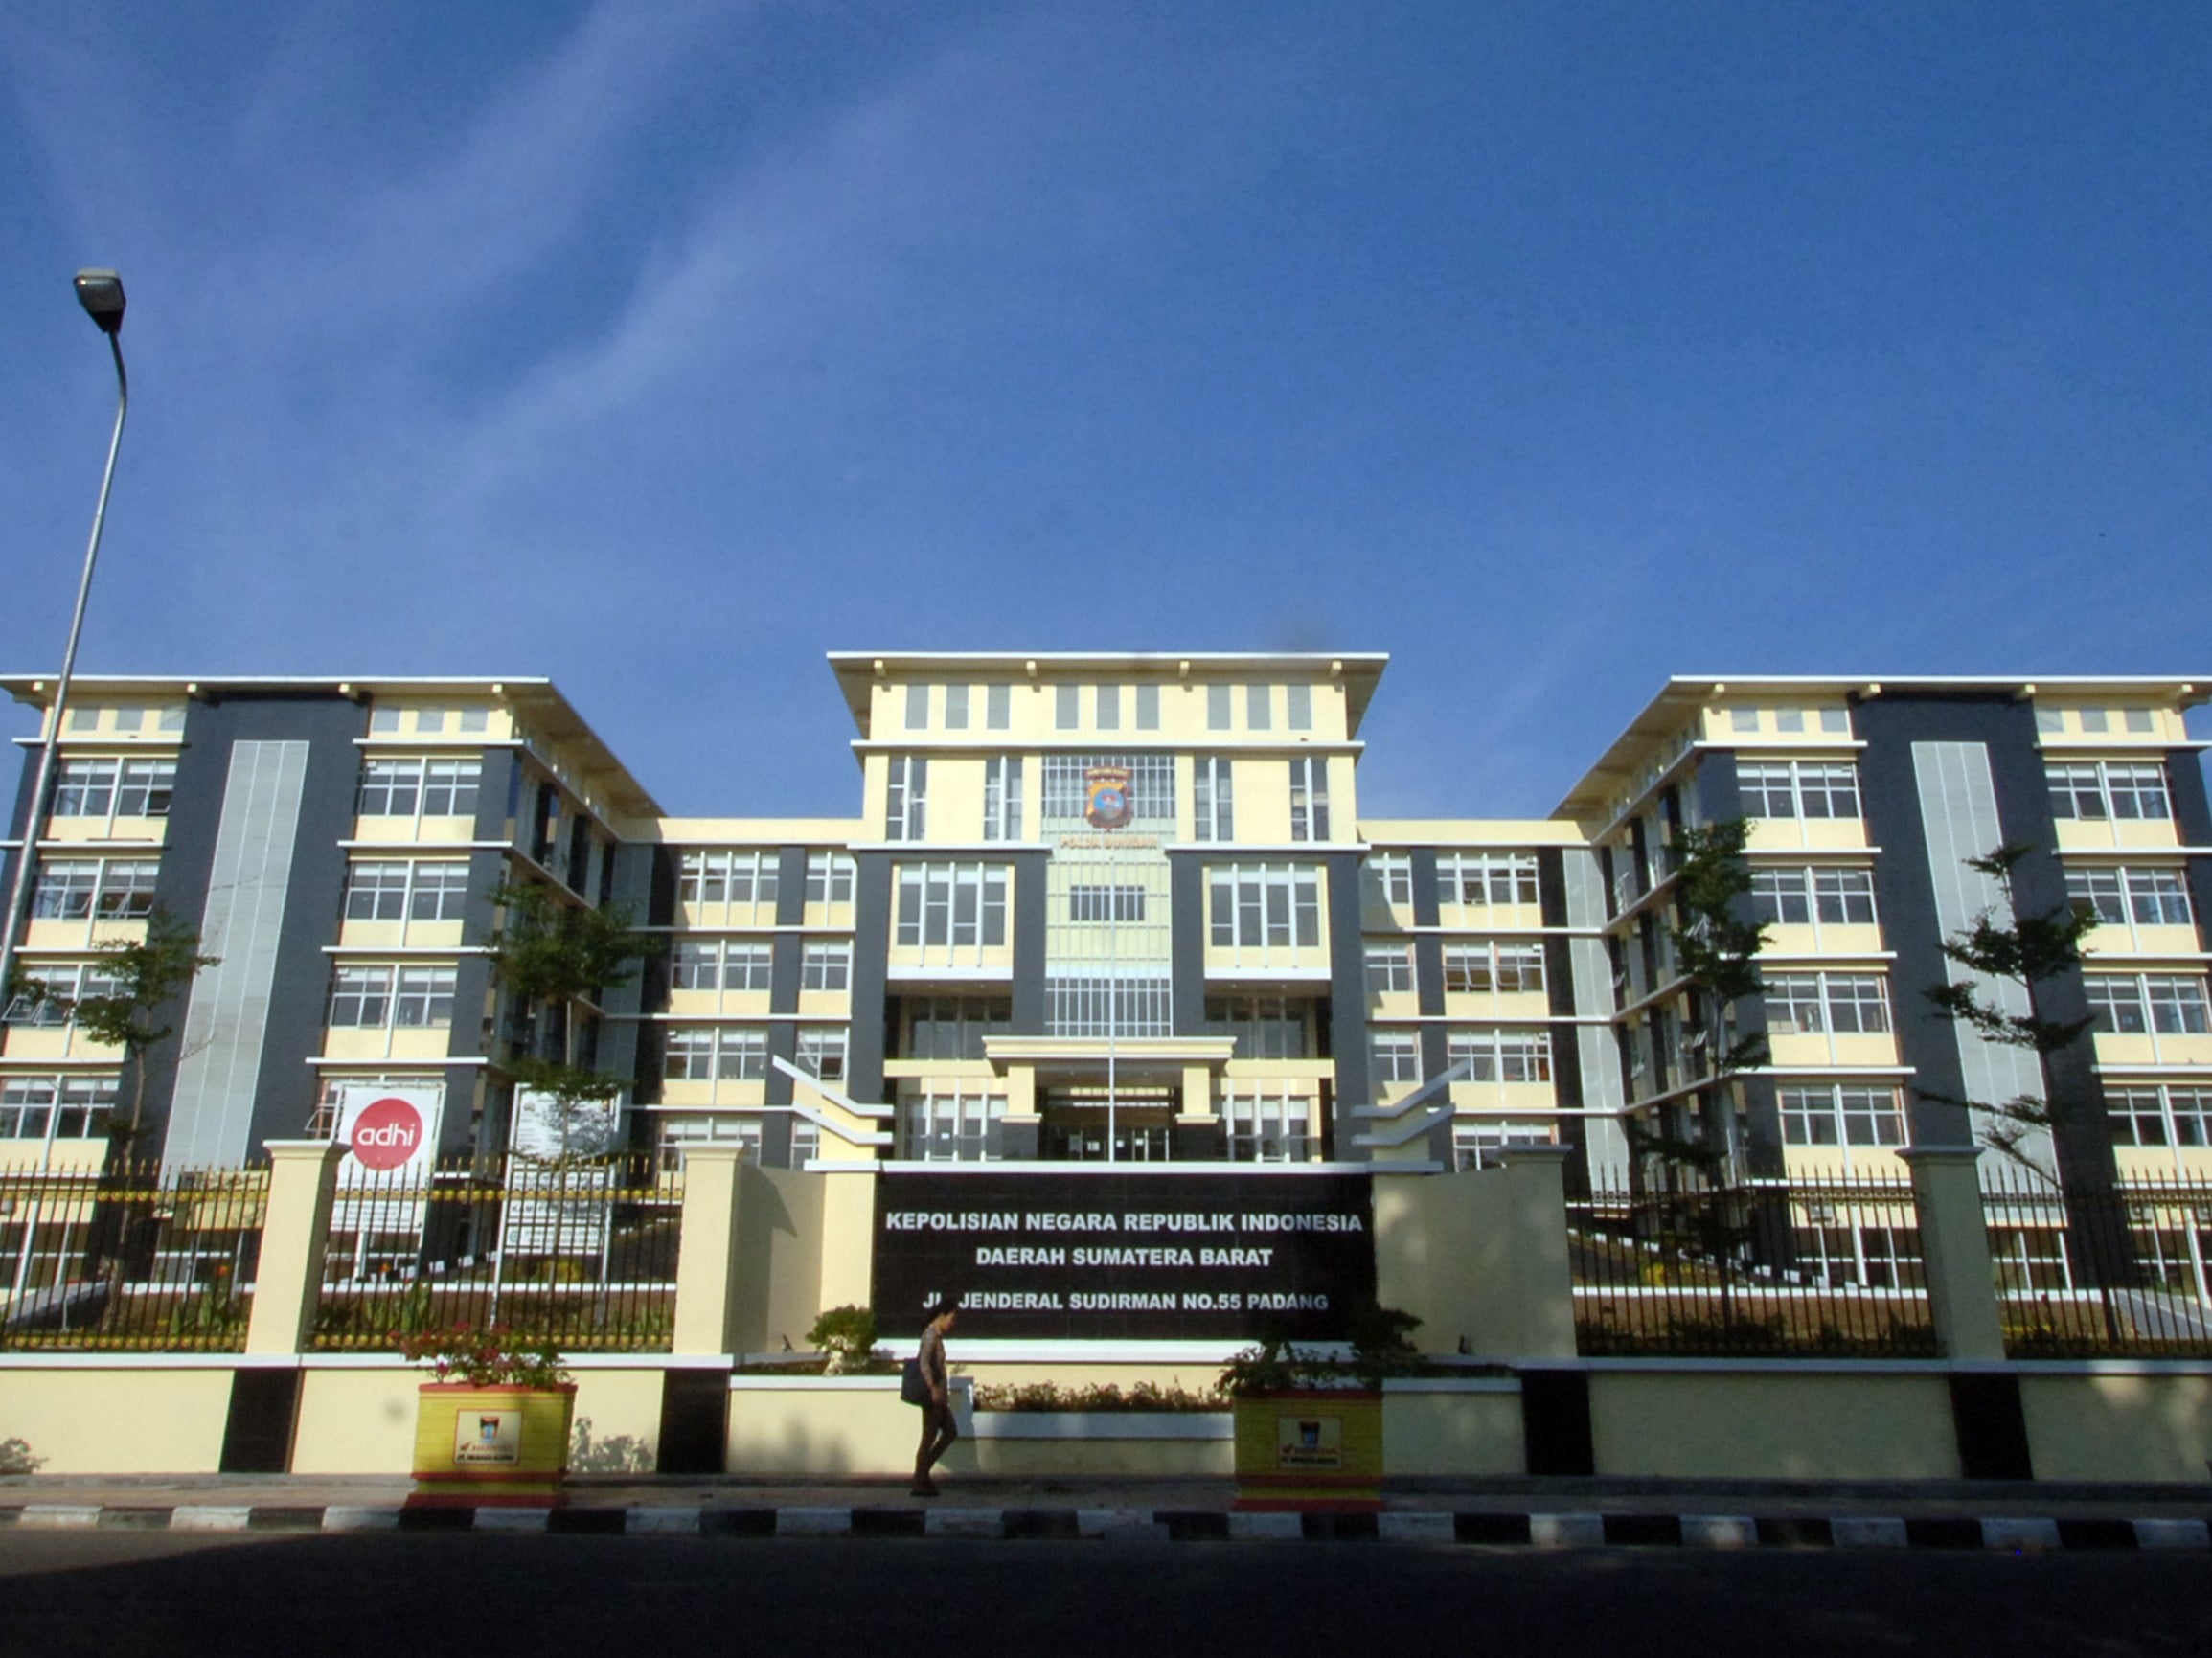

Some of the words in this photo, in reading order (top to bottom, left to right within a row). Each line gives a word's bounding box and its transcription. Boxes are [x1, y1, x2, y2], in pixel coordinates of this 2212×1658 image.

[357, 1123, 416, 1147] adhi
[886, 1212, 1018, 1230] KEPOLISIAN
[1026, 1213, 1117, 1231] NEGARA
[1124, 1214, 1235, 1232] REPUBLIK
[1242, 1214, 1363, 1232] INDONESIA
[976, 1248, 1065, 1265] DAERAH
[1072, 1248, 1194, 1266] SUMATERA
[1200, 1248, 1273, 1267] BARAT
[958, 1293, 1063, 1309] JENDERAL
[1069, 1293, 1176, 1309] SUDIRMAN
[1183, 1293, 1241, 1310] NO.55
[1247, 1294, 1328, 1310] PADANG
